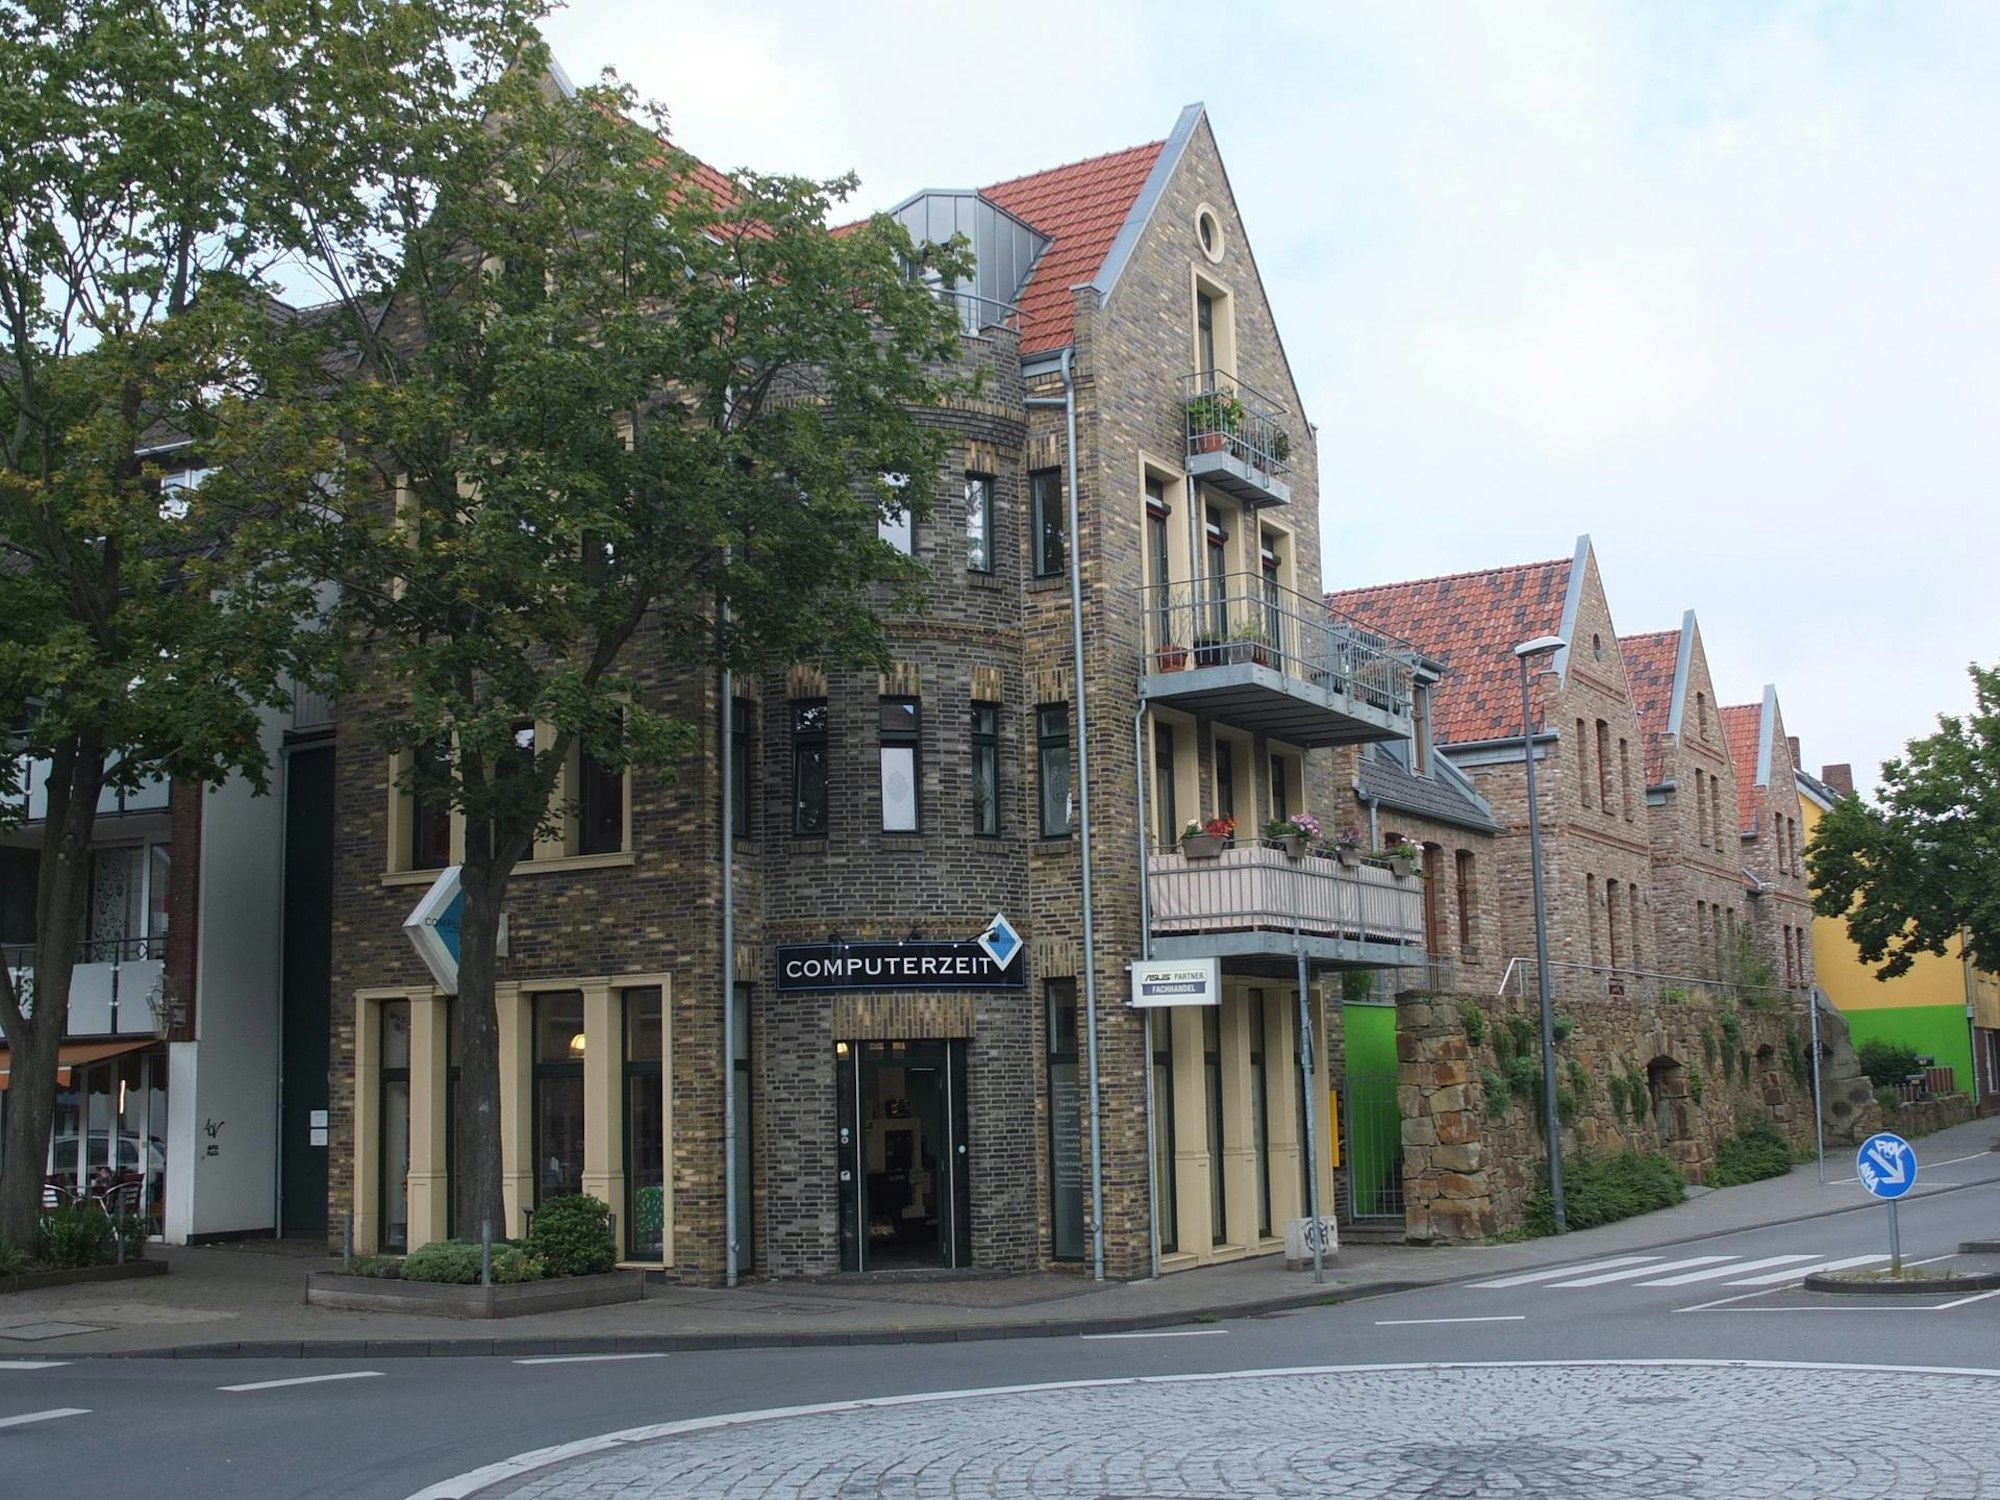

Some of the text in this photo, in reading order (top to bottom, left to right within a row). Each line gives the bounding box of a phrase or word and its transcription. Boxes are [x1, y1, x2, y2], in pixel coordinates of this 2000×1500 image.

[786, 957, 991, 977] COMPUTERZEIT
[1145, 974, 1171, 982] ASUS
[1152, 984, 1196, 993] FACHHANDEL
